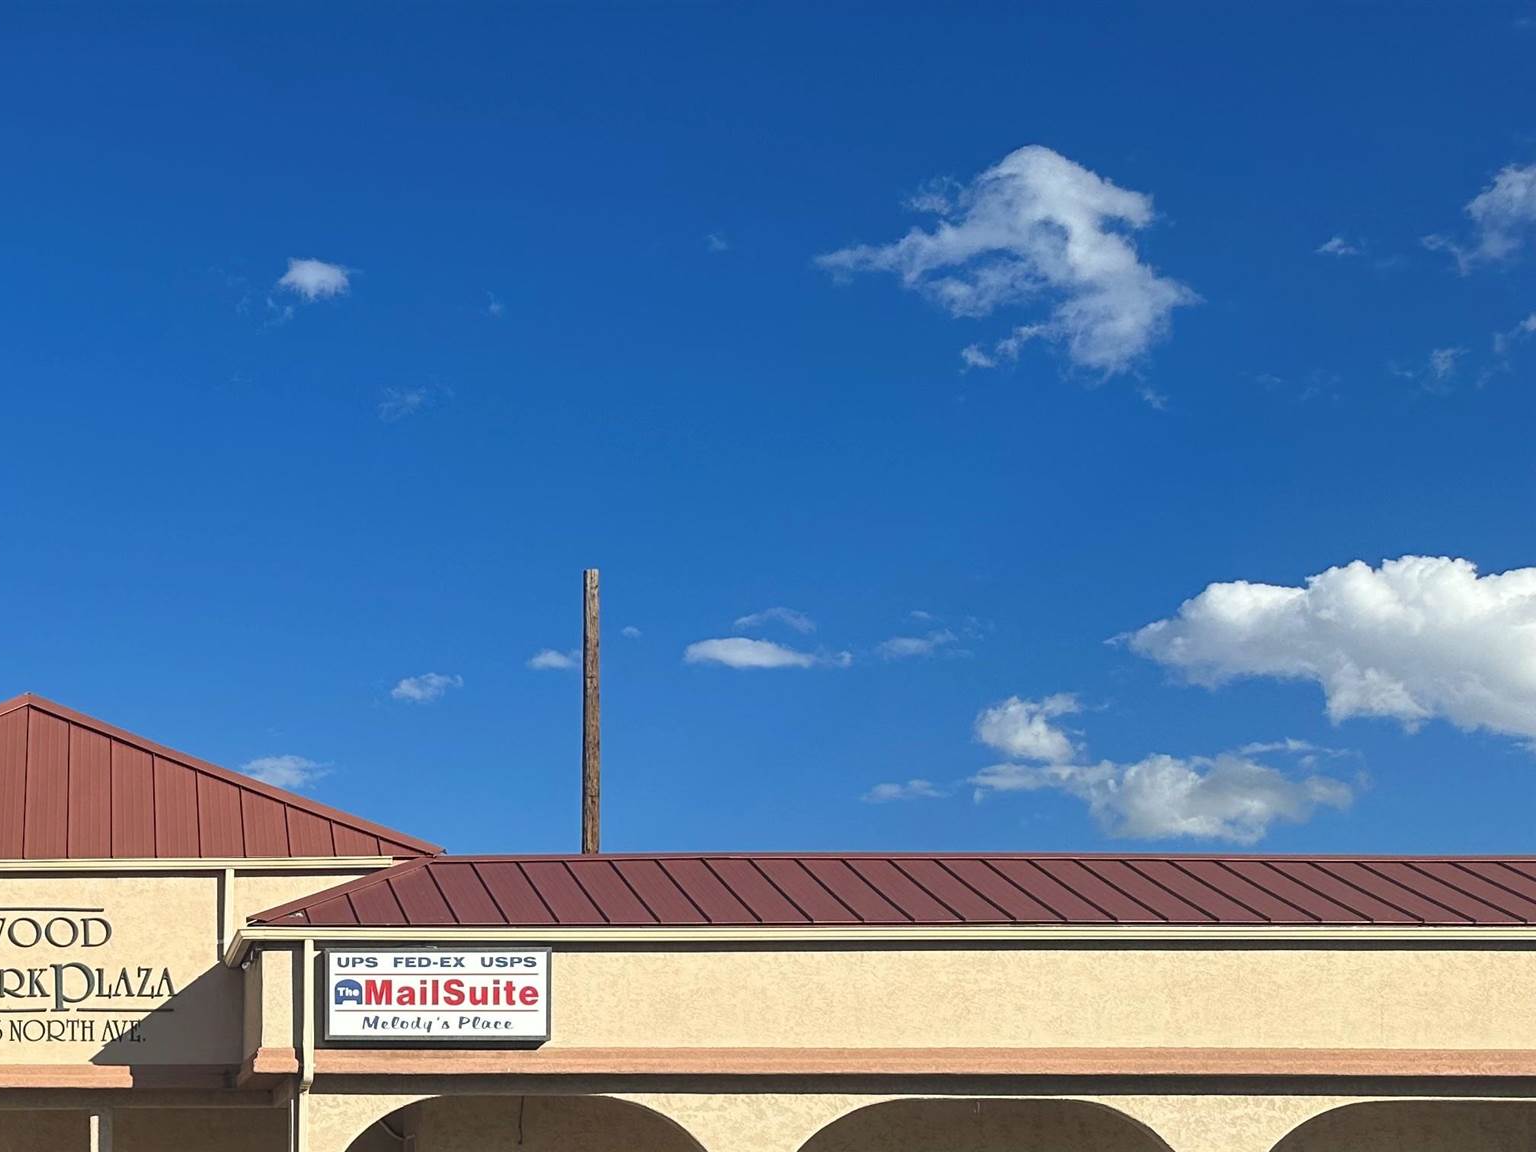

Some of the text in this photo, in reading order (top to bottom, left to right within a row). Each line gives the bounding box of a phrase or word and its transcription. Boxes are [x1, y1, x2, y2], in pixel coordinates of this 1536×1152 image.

[337, 956, 537, 968] UPS FED-EX USPS
[337, 979, 540, 1006] The MailSuite
[10, 1019, 94, 1042] NORTH
[100, 1019, 147, 1043] AVE.
[362, 1015, 514, 1033] Melody's Place
